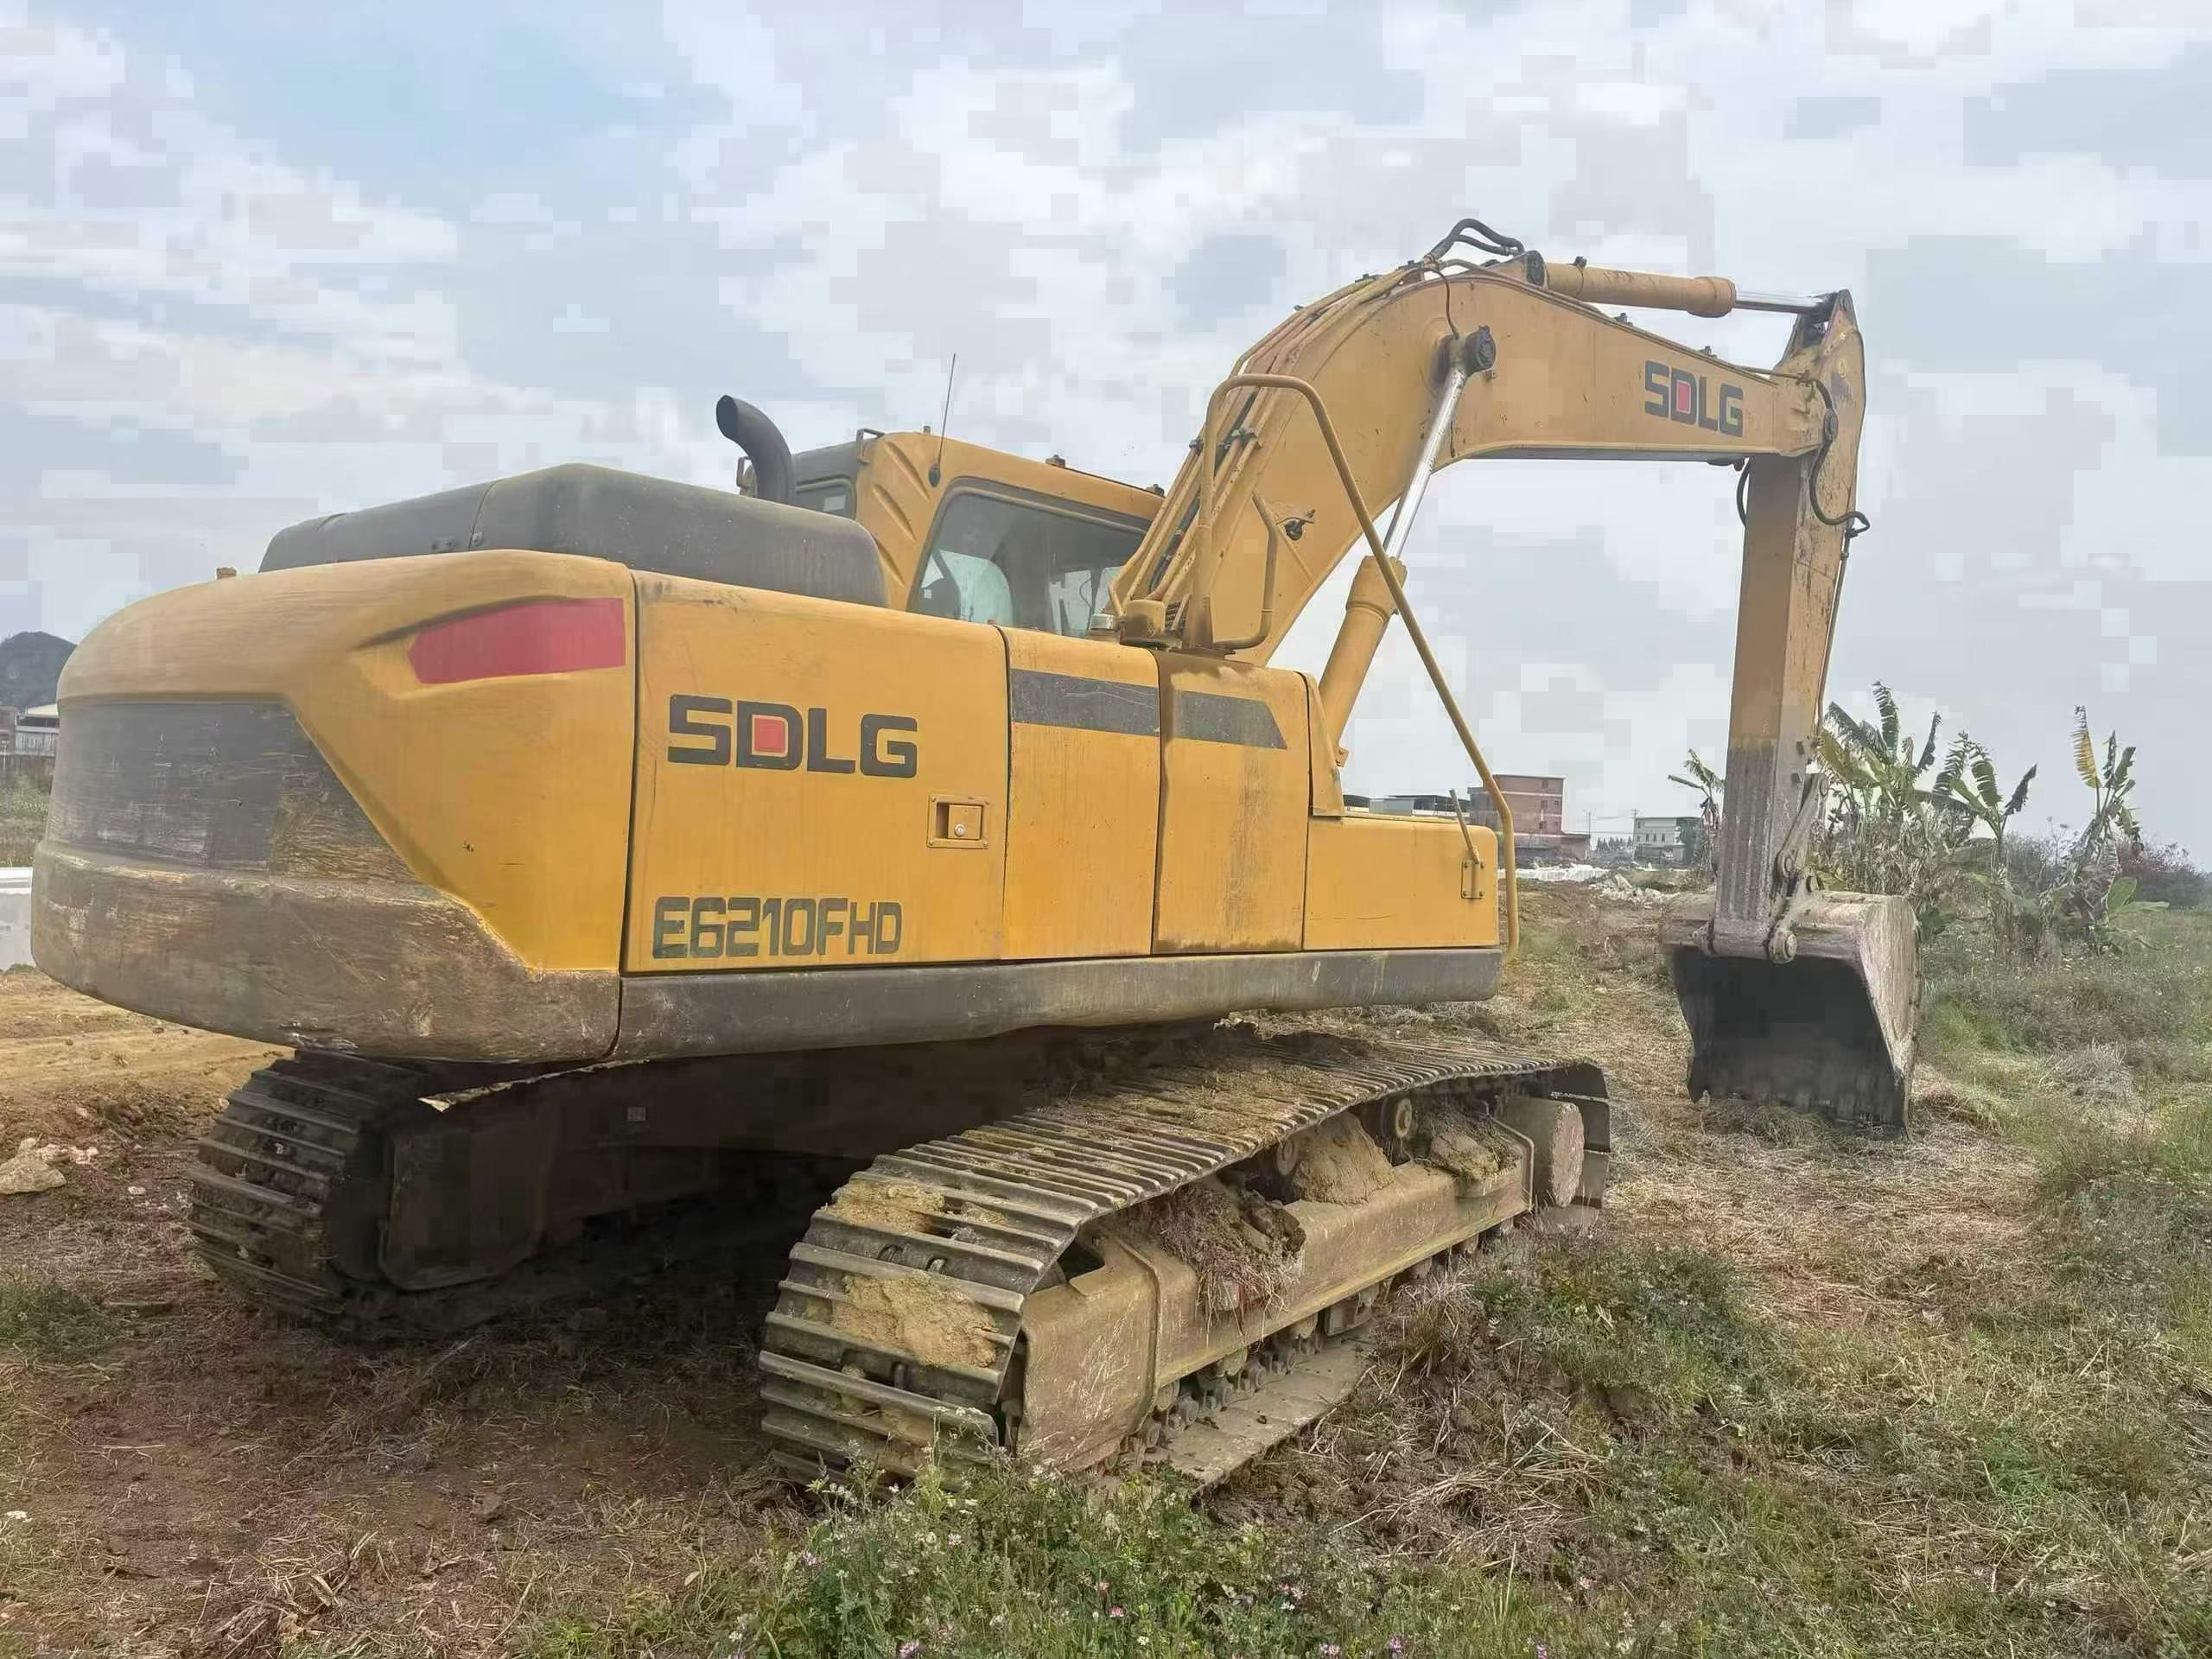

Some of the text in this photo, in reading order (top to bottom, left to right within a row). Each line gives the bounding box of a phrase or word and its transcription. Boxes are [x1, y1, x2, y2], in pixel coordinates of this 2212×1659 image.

[1645, 360, 1743, 437] SDLG
[668, 694, 918, 778] SDLG
[652, 896, 902, 958] E6210FHD
